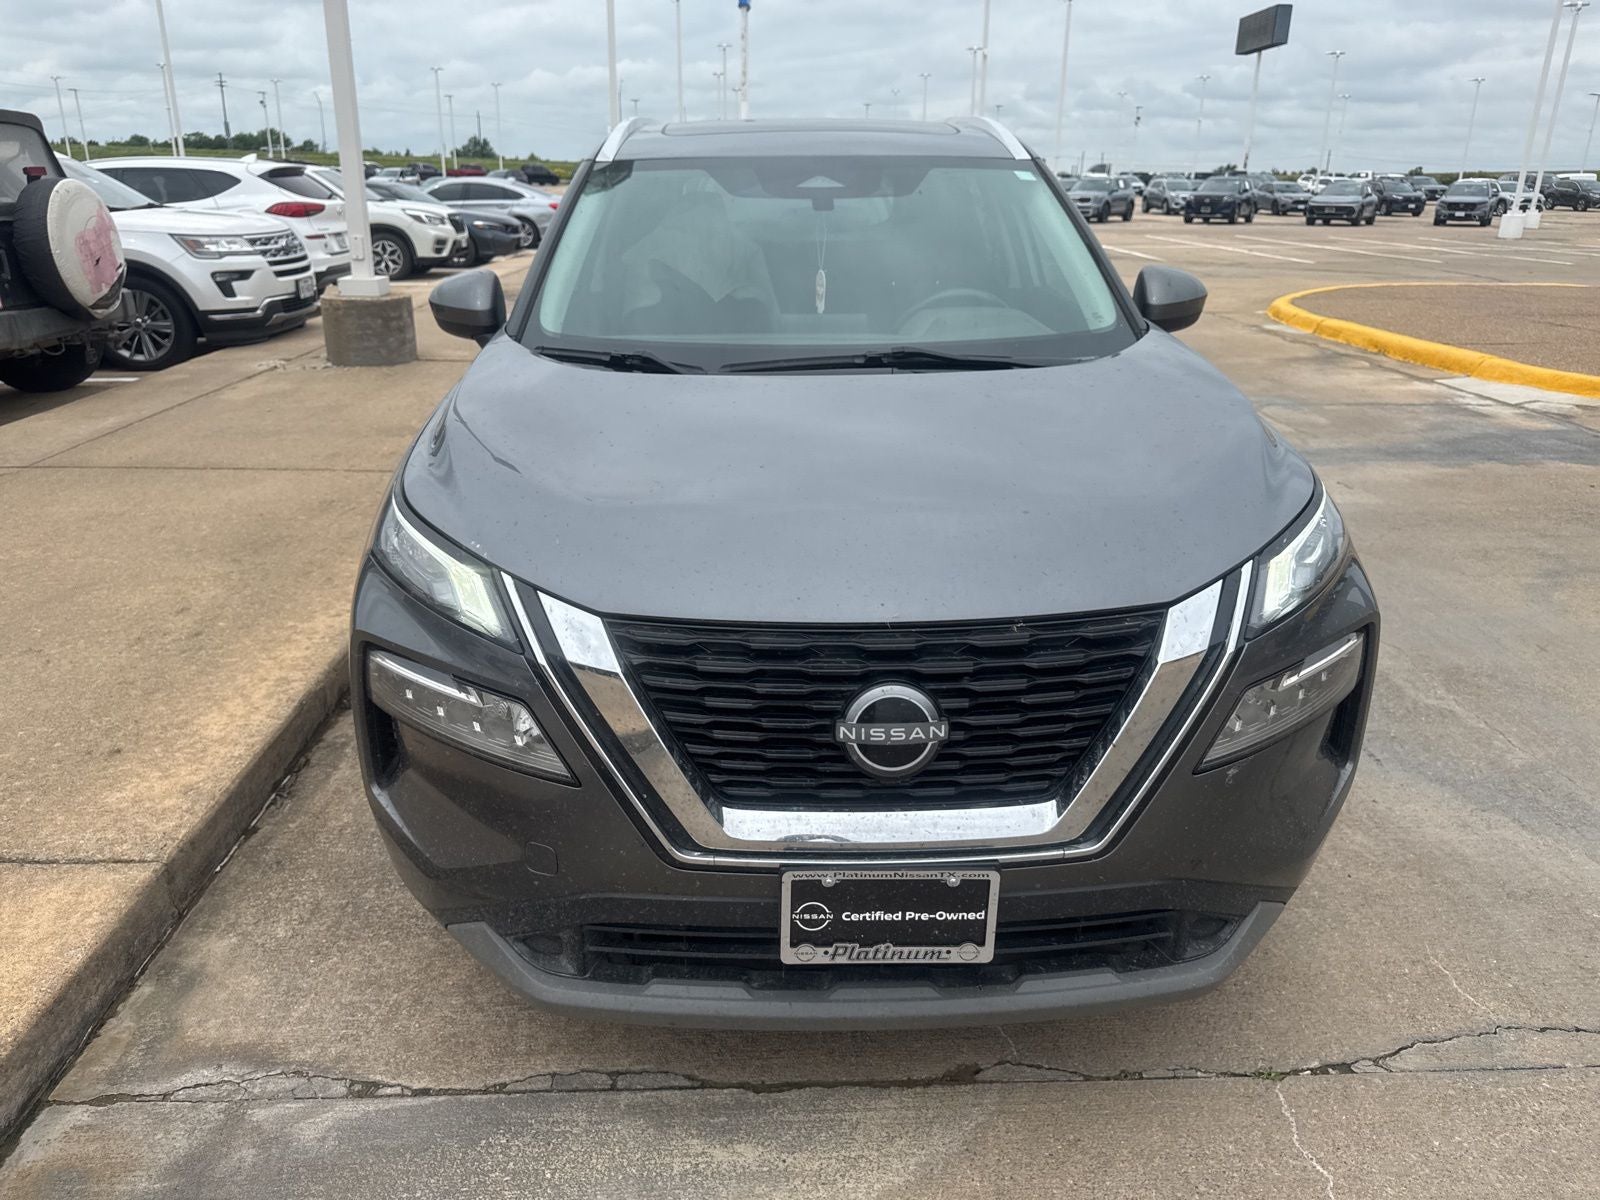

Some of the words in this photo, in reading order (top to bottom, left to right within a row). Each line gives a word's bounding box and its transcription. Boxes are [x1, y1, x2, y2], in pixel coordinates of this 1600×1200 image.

[839, 724, 945, 741] NISSAN
[792, 871, 990, 879] www.PlatinumNissanTX.com
[842, 911, 902, 921] Certified
[905, 910, 985, 921] Pre-Owned
[829, 943, 948, 961] Platinum
